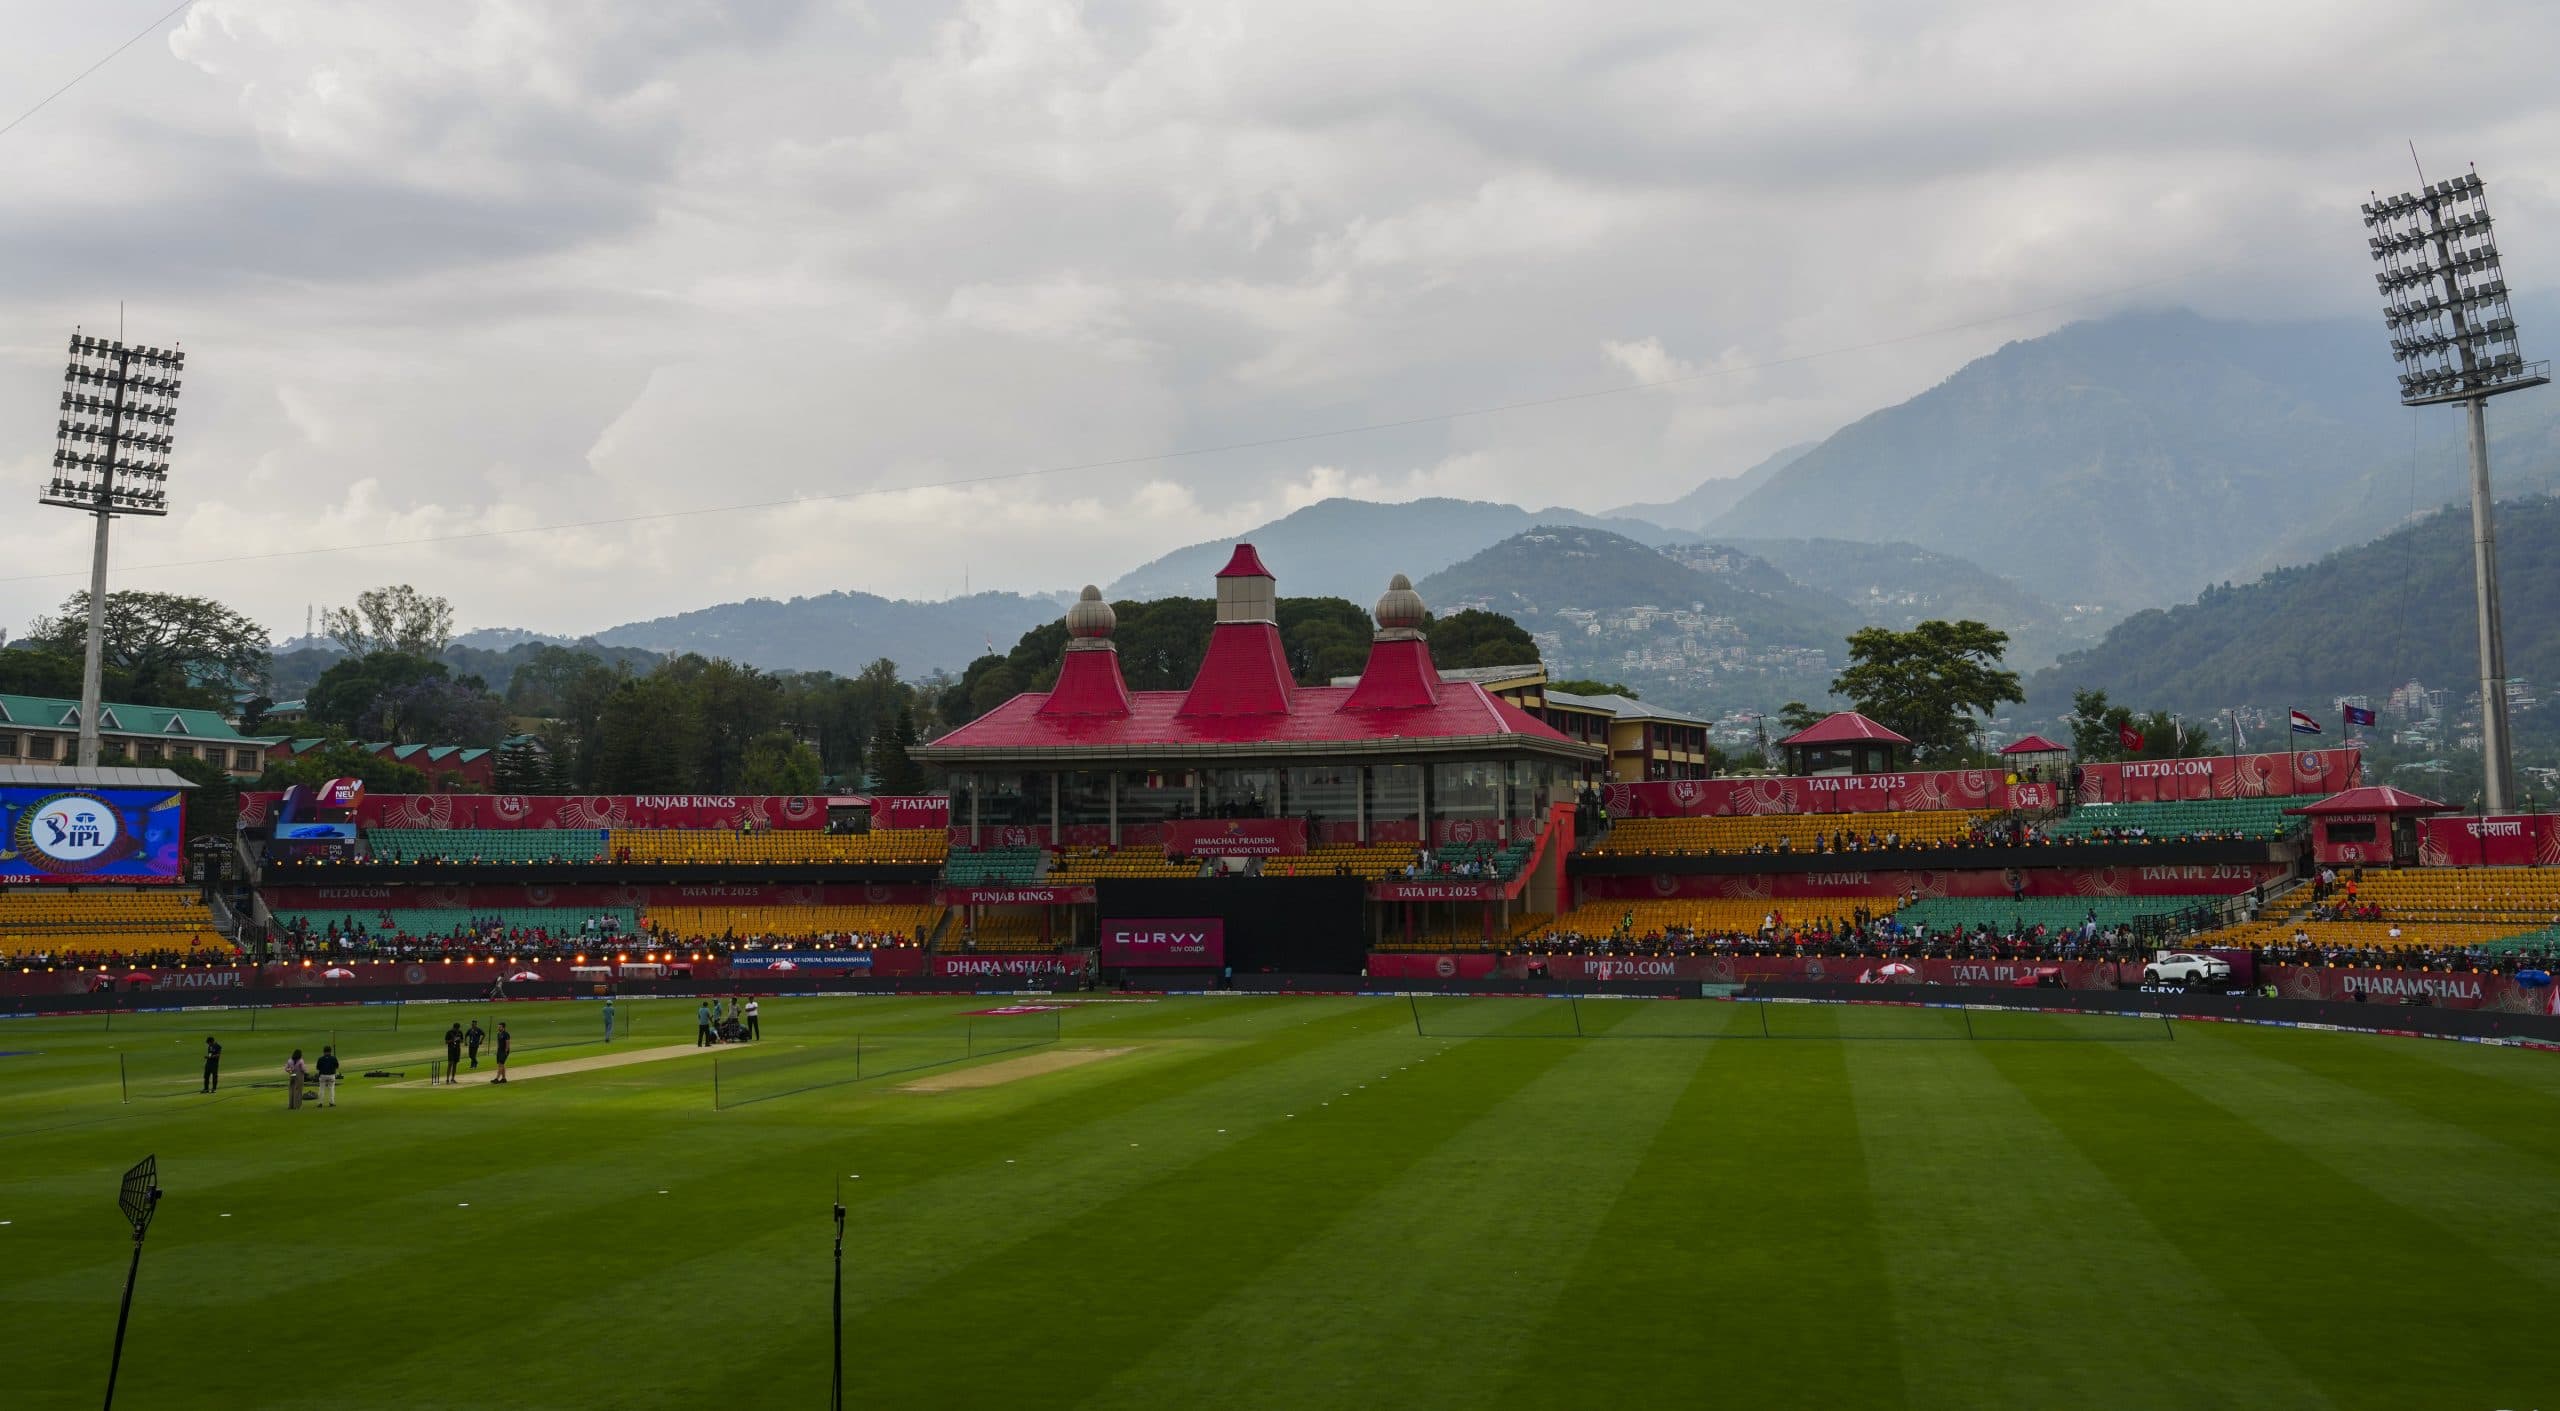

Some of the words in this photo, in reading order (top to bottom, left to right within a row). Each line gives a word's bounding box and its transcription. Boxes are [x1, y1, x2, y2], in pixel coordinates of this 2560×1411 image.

[2122, 761, 2213, 778] IPLT20.COM
[1807, 778, 1840, 791] TATA
[1844, 778, 1865, 789] IPL
[1870, 776, 1905, 789] 2025
[636, 796, 689, 810] PUNJAB
[692, 797, 736, 808] KINGS
[2027, 797, 2040, 805] IPL
[2466, 817, 2521, 838] धर्मशाला
[69, 832, 104, 846] IPL
[1192, 847, 1226, 855] CRICKET
[1227, 846, 1280, 854] ASSOCIATION
[3, 875, 31, 883] 2025
[1807, 871, 1872, 885] #TATAIPL
[2140, 866, 2179, 880] TATA
[2183, 865, 2206, 879] IPL
[2211, 865, 2251, 879] 2025
[320, 888, 393, 898] IPLT20.COM
[680, 887, 707, 897] TATA
[711, 887, 728, 896] IPL
[730, 887, 759, 896] 2025
[971, 891, 1015, 904] PUNJAB
[1018, 891, 1054, 901] KINGS
[1396, 887, 1425, 897] TATA
[1428, 887, 1445, 897] IPL
[1448, 886, 1478, 897] 2025
[1115, 932, 1204, 943] CURVV
[946, 960, 1066, 973] DHARAMSHA
[1950, 965, 1990, 981] TATA
[1994, 966, 2017, 981] IPL
[2343, 976, 2482, 999] DHARAMSHALA
